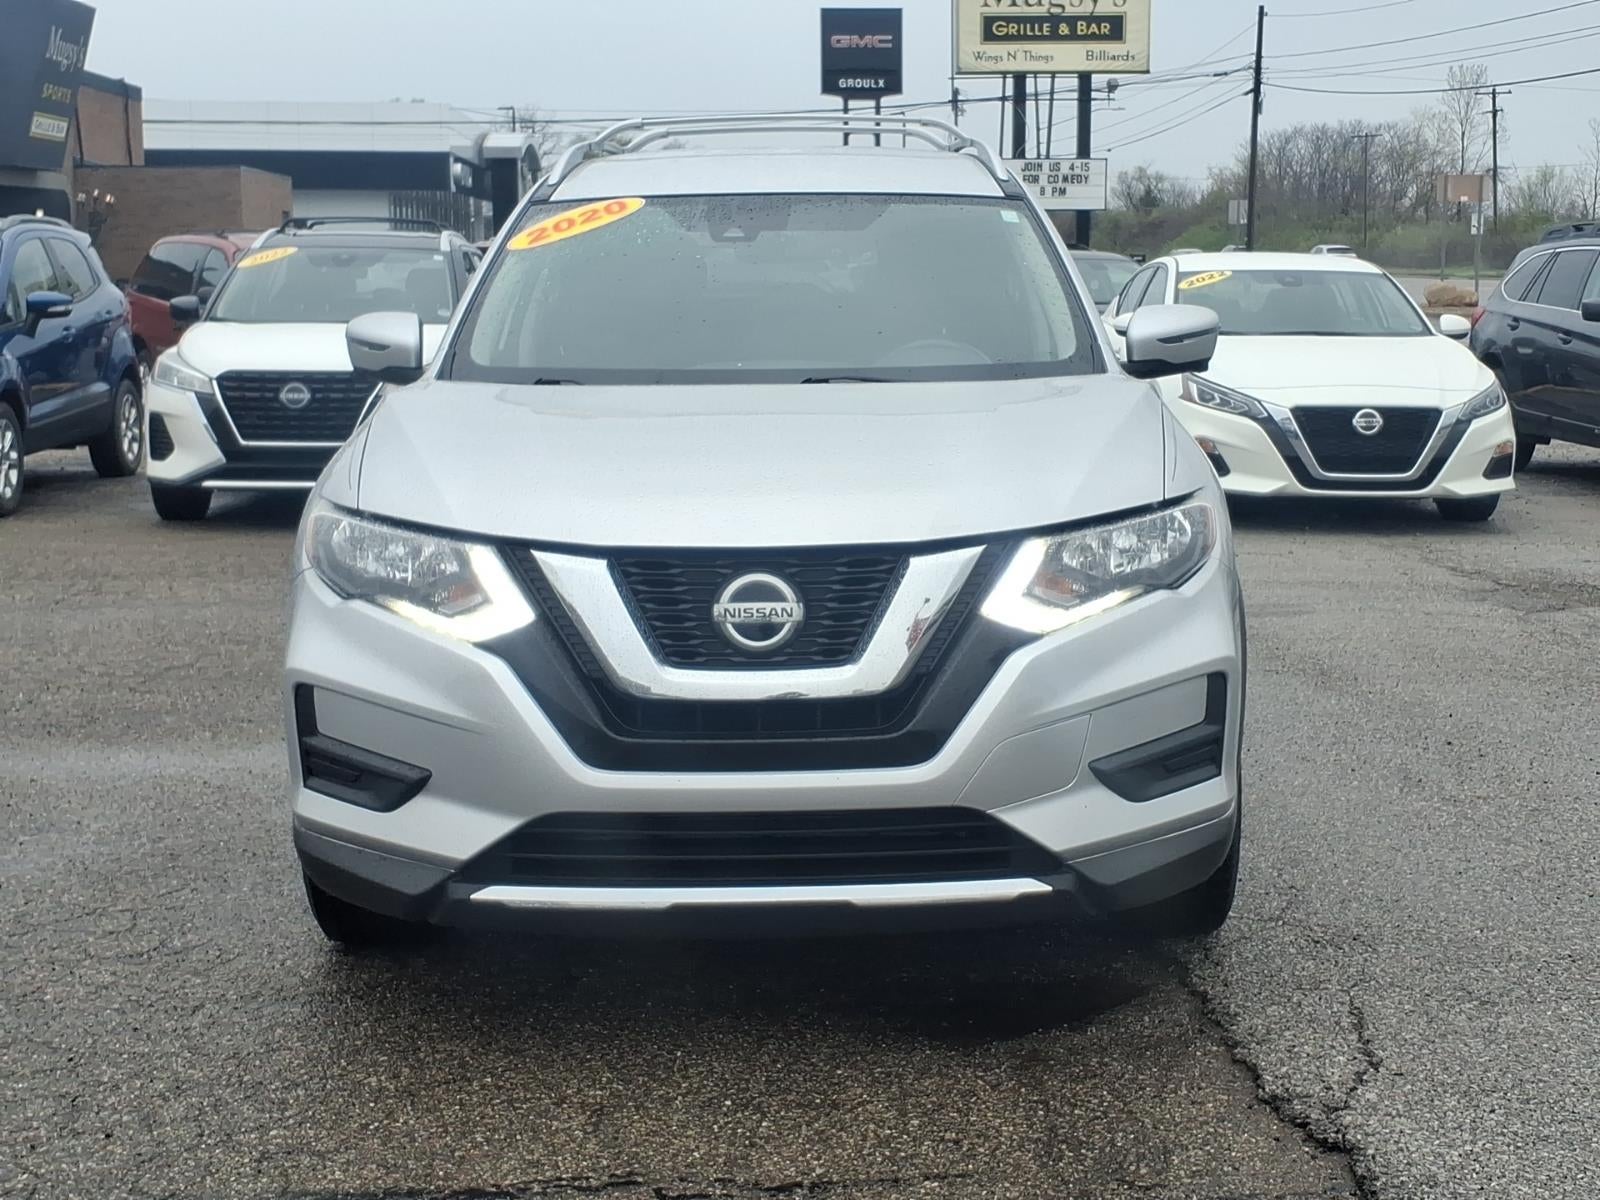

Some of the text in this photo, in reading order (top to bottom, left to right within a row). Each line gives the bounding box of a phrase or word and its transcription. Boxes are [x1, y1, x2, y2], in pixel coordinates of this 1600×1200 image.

[992, 21, 1111, 36] GRILLE & BAR
[831, 35, 893, 48] GMC
[972, 51, 1004, 64] Wings
[1023, 51, 1054, 64] Things
[1085, 50, 1136, 62] Billiards
[838, 78, 885, 88] GROULX
[1021, 162, 1090, 172] JOIN US 4-15
[1022, 174, 1040, 184] FOR
[1039, 186, 1067, 196] 8 PM
[526, 201, 626, 245] 2020
[723, 607, 794, 619] NISSAN
